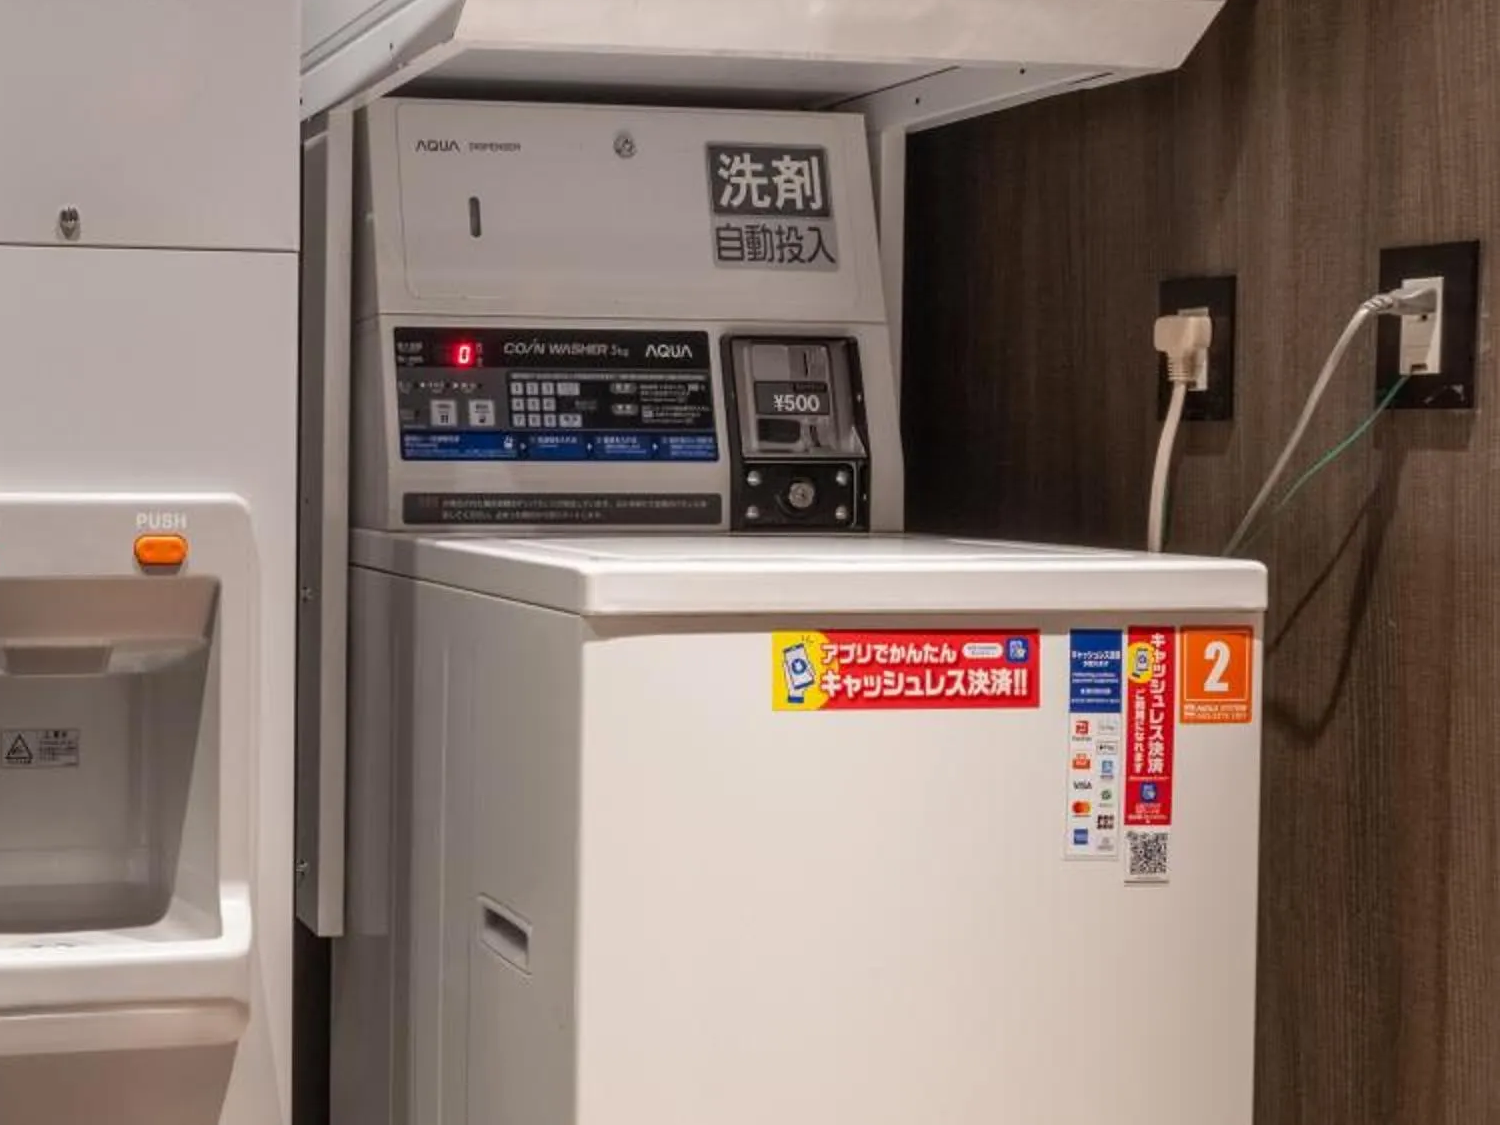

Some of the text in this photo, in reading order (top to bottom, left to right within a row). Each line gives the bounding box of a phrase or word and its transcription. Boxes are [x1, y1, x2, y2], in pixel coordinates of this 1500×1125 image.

[414, 139, 460, 153] AQUA
[717, 152, 824, 211] 洗剤
[715, 223, 837, 265] 自動投入
[549, 342, 608, 358] WASHER
[645, 343, 693, 359] AQUA
[773, 394, 821, 412] ¥500
[135, 512, 188, 530] PUSH
[820, 642, 958, 665] アプリでかんたん
[1203, 641, 1232, 693] 2
[820, 668, 1028, 698] キャッシュレス決済!!
